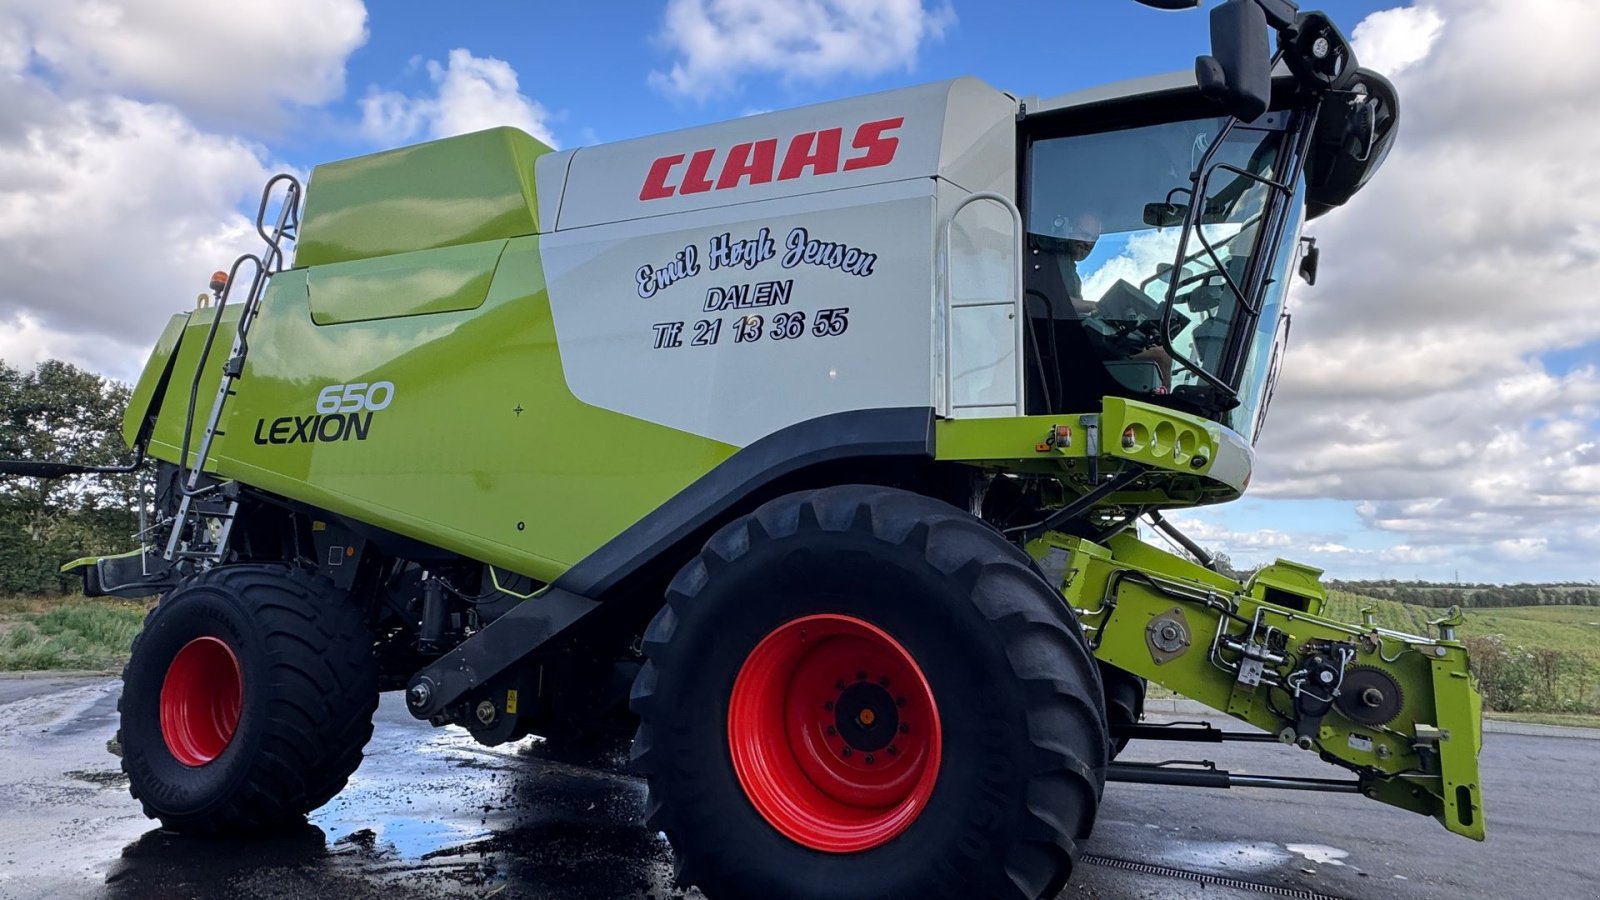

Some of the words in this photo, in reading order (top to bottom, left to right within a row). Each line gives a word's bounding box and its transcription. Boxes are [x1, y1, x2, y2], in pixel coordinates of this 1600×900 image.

[639, 117, 904, 201] CLAAS
[635, 245, 700, 298] Emil
[709, 227, 775, 270] Høgh
[781, 227, 877, 276] Jensen
[703, 279, 793, 312] DALEN
[691, 318, 722, 346] 21
[732, 315, 764, 343] 13
[770, 312, 806, 340] 36
[812, 308, 849, 337] 55
[316, 381, 395, 414] 650
[254, 412, 373, 445] LEXION
